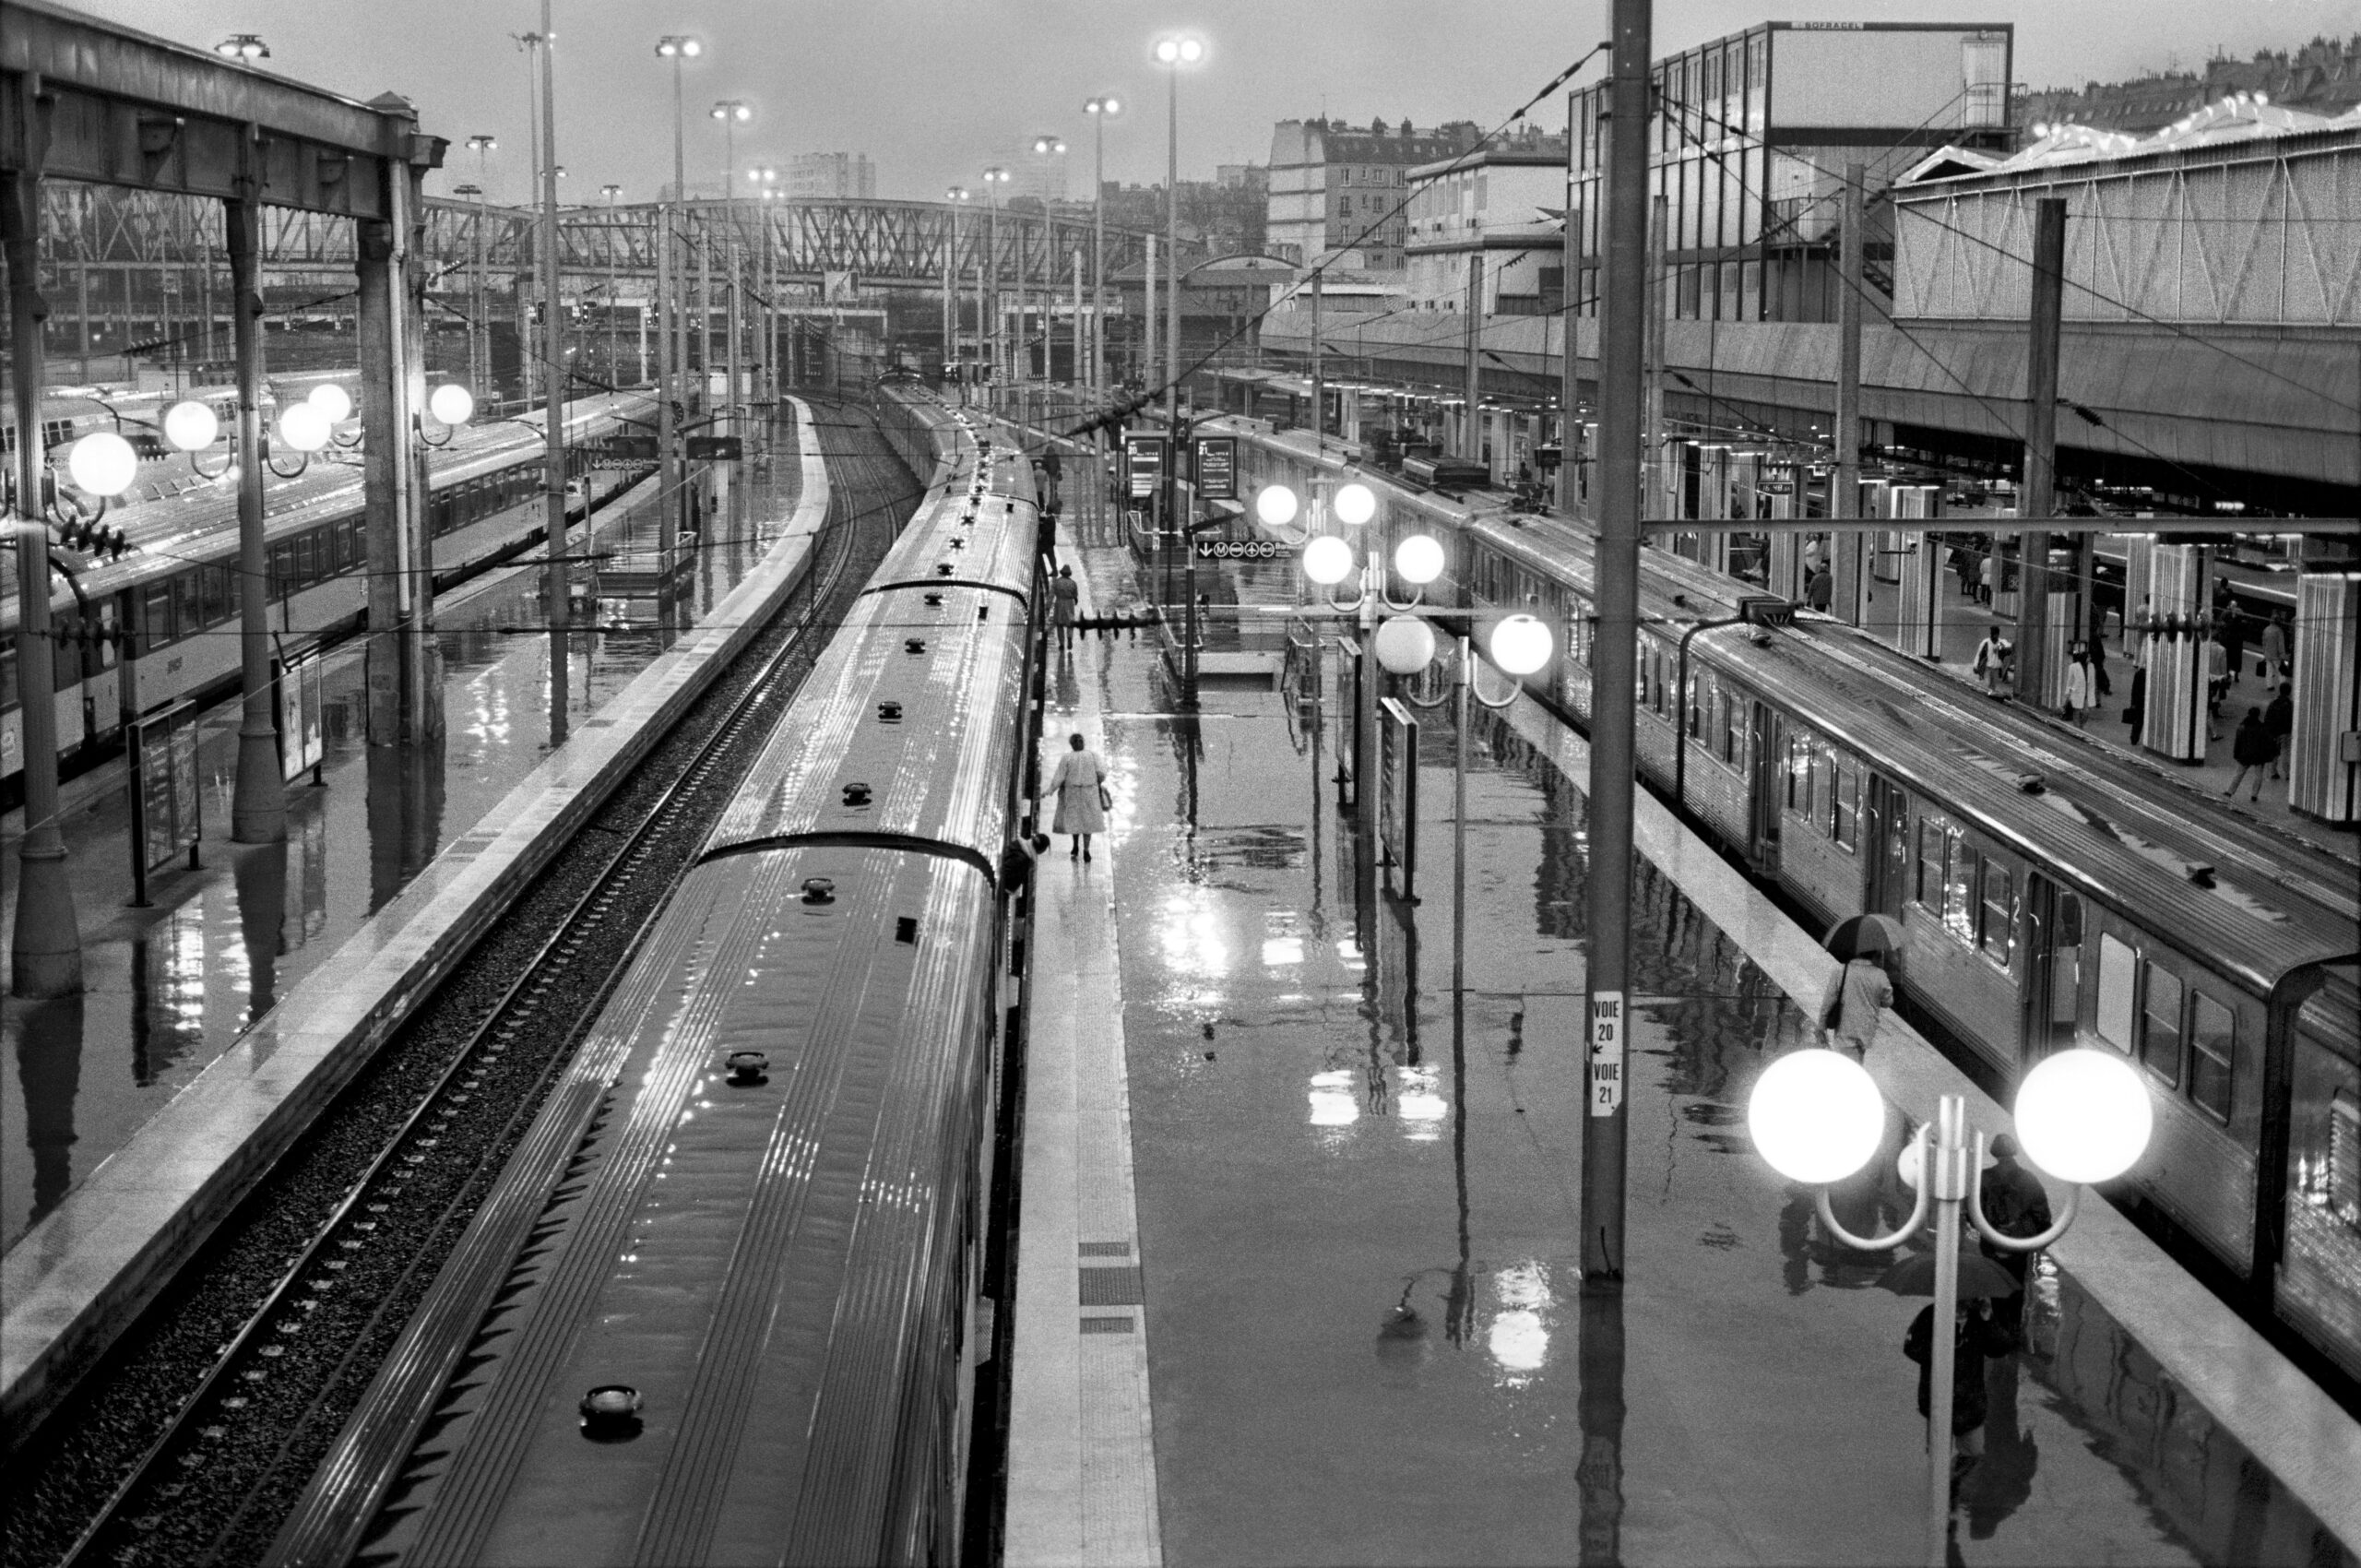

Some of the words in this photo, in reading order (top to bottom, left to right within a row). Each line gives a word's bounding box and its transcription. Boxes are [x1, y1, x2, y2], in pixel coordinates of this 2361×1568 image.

[1805, 21, 1860, 30] SOFRACEL
[1128, 446, 1137, 455] 20
[1199, 446, 1208, 455] 21
[2013, 896, 2020, 923] 2
[1595, 1001, 1619, 1017] VOIE
[1598, 1024, 1613, 1040] 20
[1595, 1063, 1619, 1080] VOIE
[1599, 1087, 1611, 1103] 21
